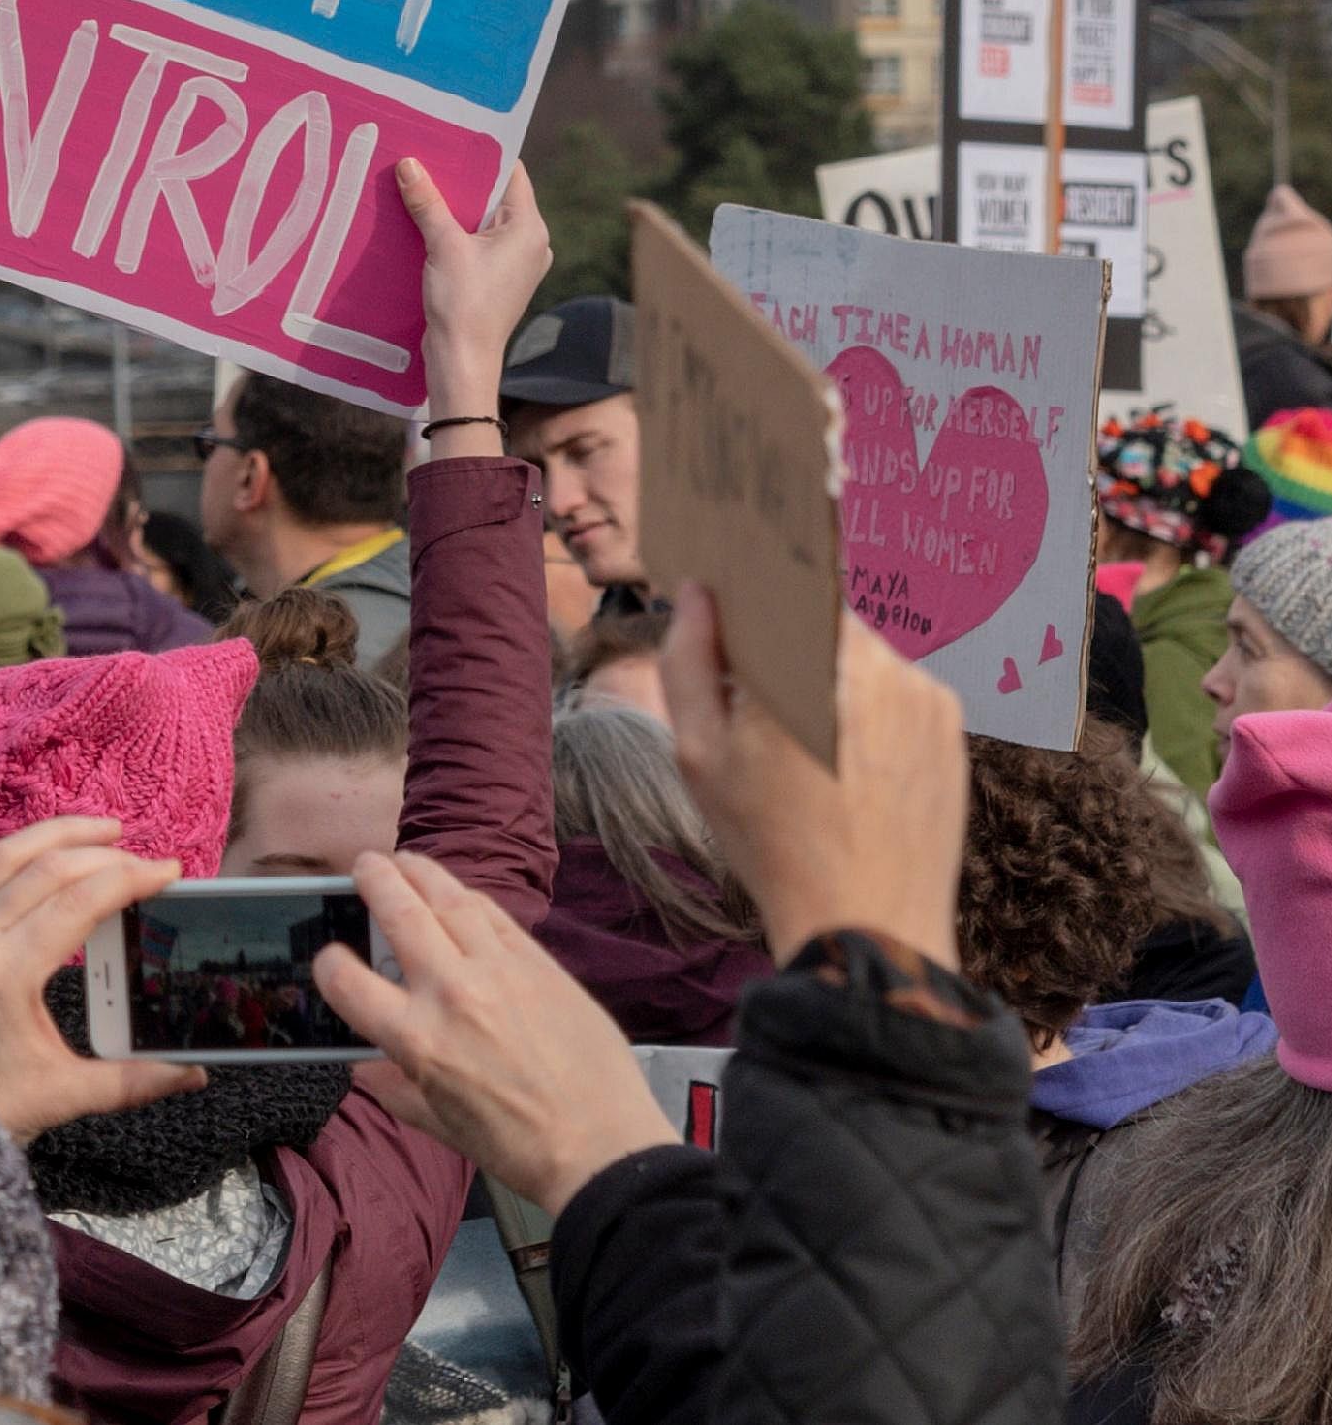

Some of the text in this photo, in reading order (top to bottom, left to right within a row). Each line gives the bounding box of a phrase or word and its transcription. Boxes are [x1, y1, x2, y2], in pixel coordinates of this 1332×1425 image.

[831, 304, 911, 354] TIME
[914, 321, 931, 360] A
[939, 324, 1041, 380] WOMAN
[866, 383, 893, 427] UP
[900, 386, 939, 432] FOR
[929, 462, 964, 522] UP
[968, 466, 1016, 520] FOR
[902, 510, 999, 576] WOMEN
